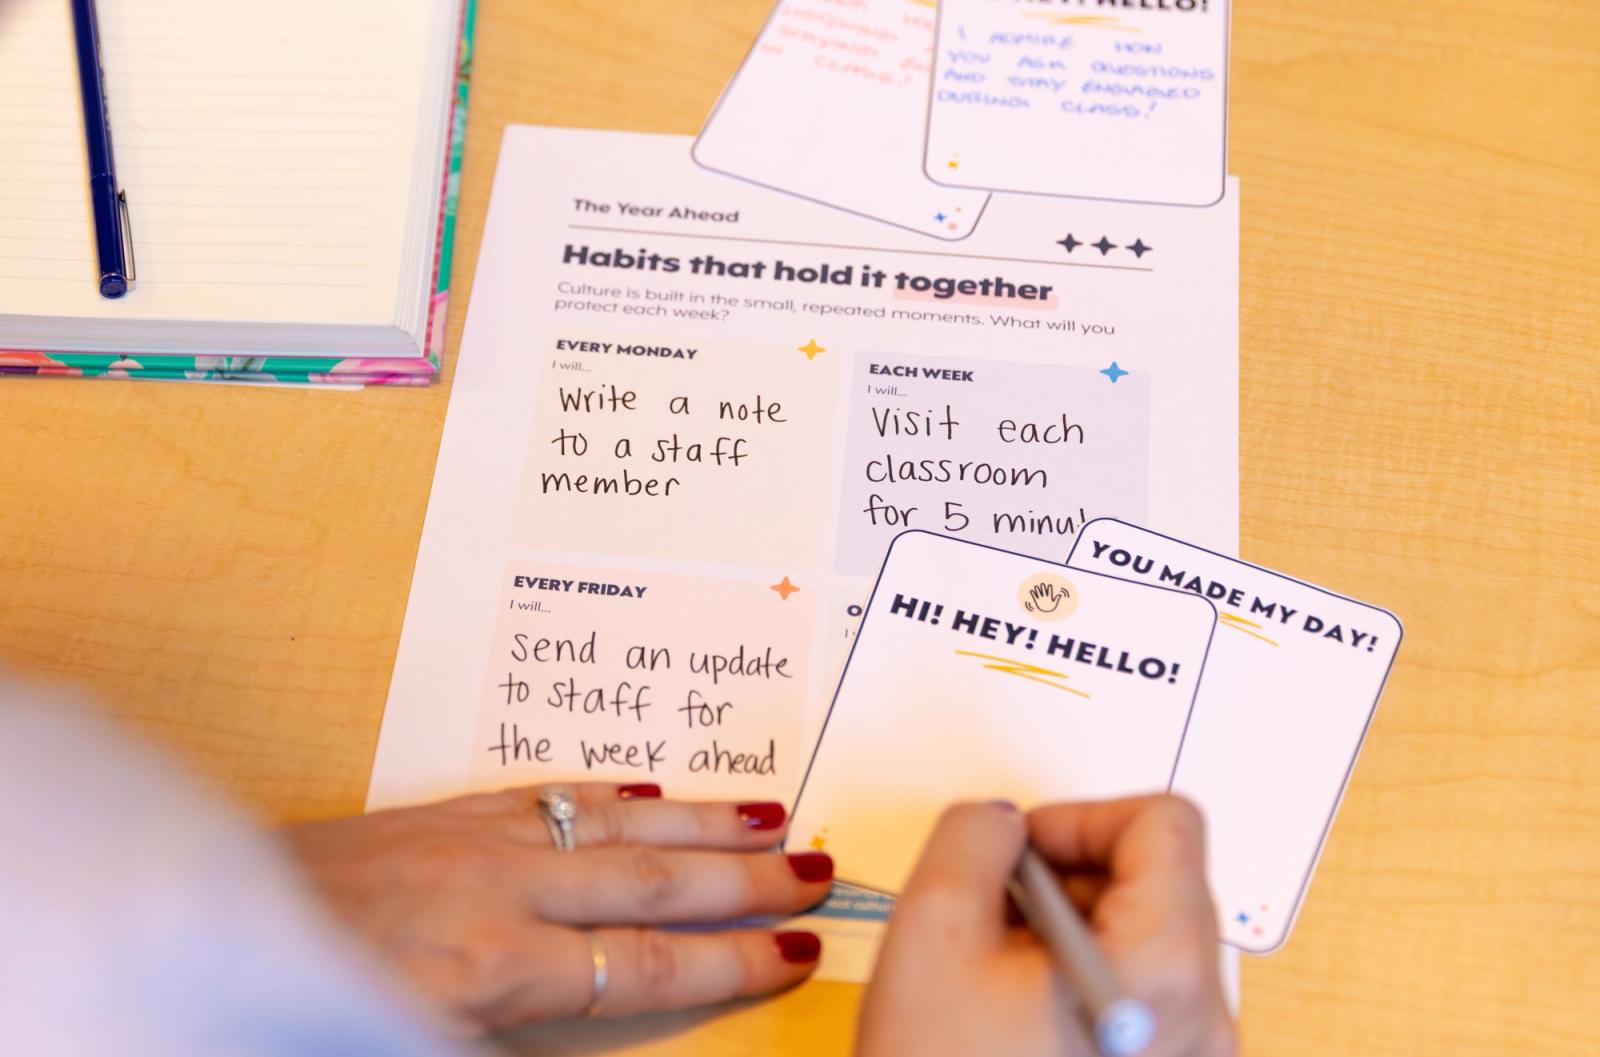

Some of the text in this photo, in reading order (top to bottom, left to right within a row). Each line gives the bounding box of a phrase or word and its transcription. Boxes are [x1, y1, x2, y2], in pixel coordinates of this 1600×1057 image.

[946, 49, 992, 63] YOU
[1091, 60, 1215, 81] QUESTIONS
[943, 67, 1201, 99] AND STAY ENGAGED
[1060, 99, 1158, 120] CLASS!
[573, 198, 740, 223] The Year Ahead
[562, 244, 1053, 300] Habits that hold it together
[553, 298, 731, 322] protect each week?
[557, 281, 1115, 335] Culture is built in the small, repeated moments. What will you
[556, 339, 698, 360] EVERY MONDAY
[560, 362, 592, 372] will...
[869, 363, 975, 382] EACH WEEK
[874, 385, 908, 398] will...
[669, 396, 690, 415] a
[719, 395, 788, 424] note
[996, 413, 1084, 444] each
[551, 428, 748, 467] to a staff
[541, 469, 680, 496] member
[865, 454, 1048, 488] classroom
[863, 493, 918, 527] for
[944, 501, 970, 531] 5
[513, 575, 648, 599] EVERY FRIDAY
[1091, 540, 1379, 653] YOU MADE MY DAY!
[517, 600, 552, 613] will...
[889, 593, 1180, 684] HI! HEY! HELLO!
[625, 645, 670, 671] an
[690, 645, 793, 684] update
[498, 672, 733, 728] to staff for
[487, 722, 776, 775] the week ahead
